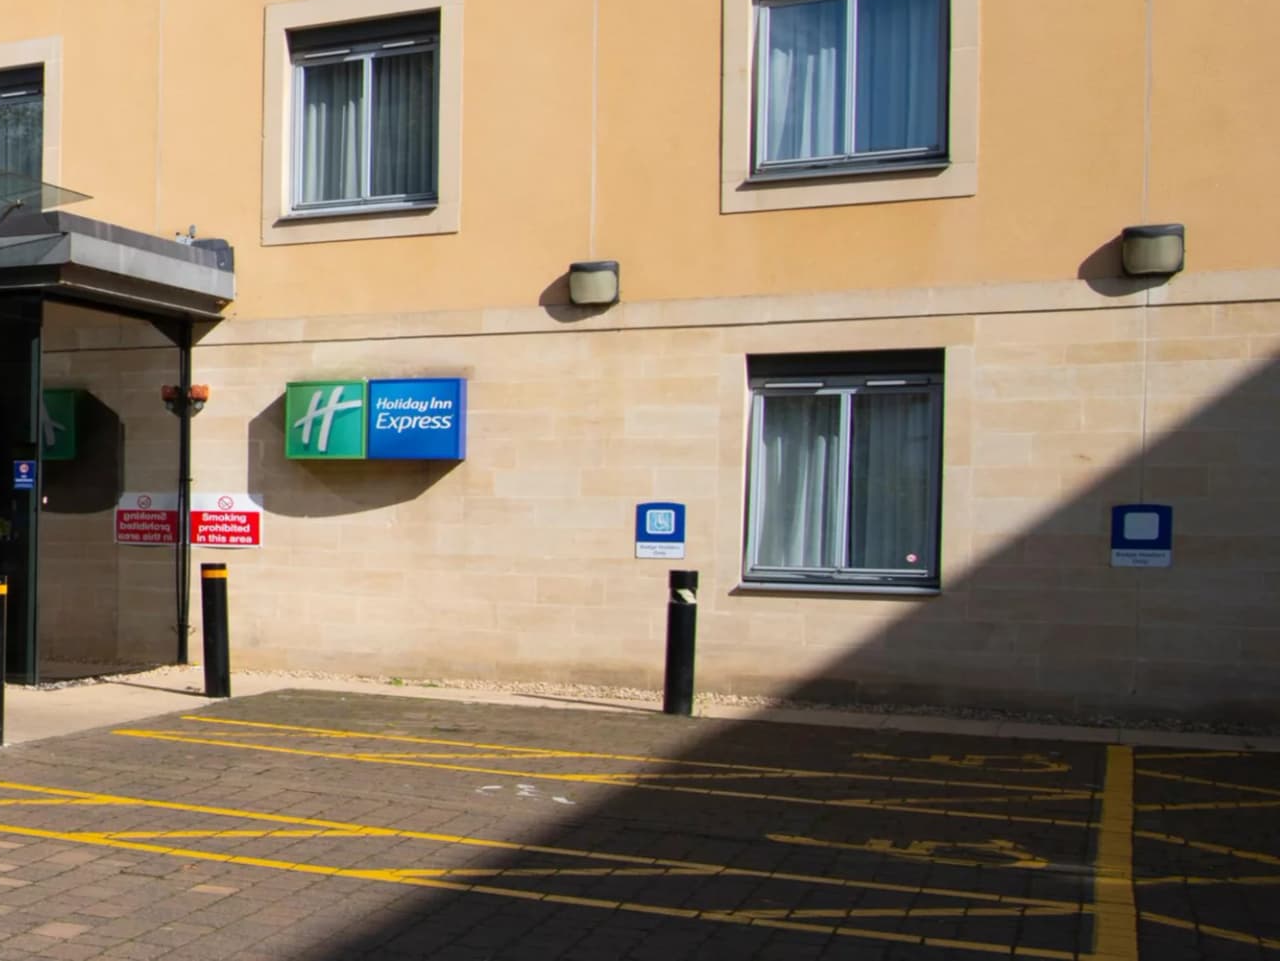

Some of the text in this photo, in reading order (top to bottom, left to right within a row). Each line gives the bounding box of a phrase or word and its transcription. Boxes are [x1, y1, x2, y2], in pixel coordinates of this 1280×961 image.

[375, 397, 453, 412] Holiday Inn
[375, 412, 453, 434] Express
[202, 512, 247, 524] Smoking
[198, 524, 250, 534] prohibited
[196, 534, 252, 544] in this area
